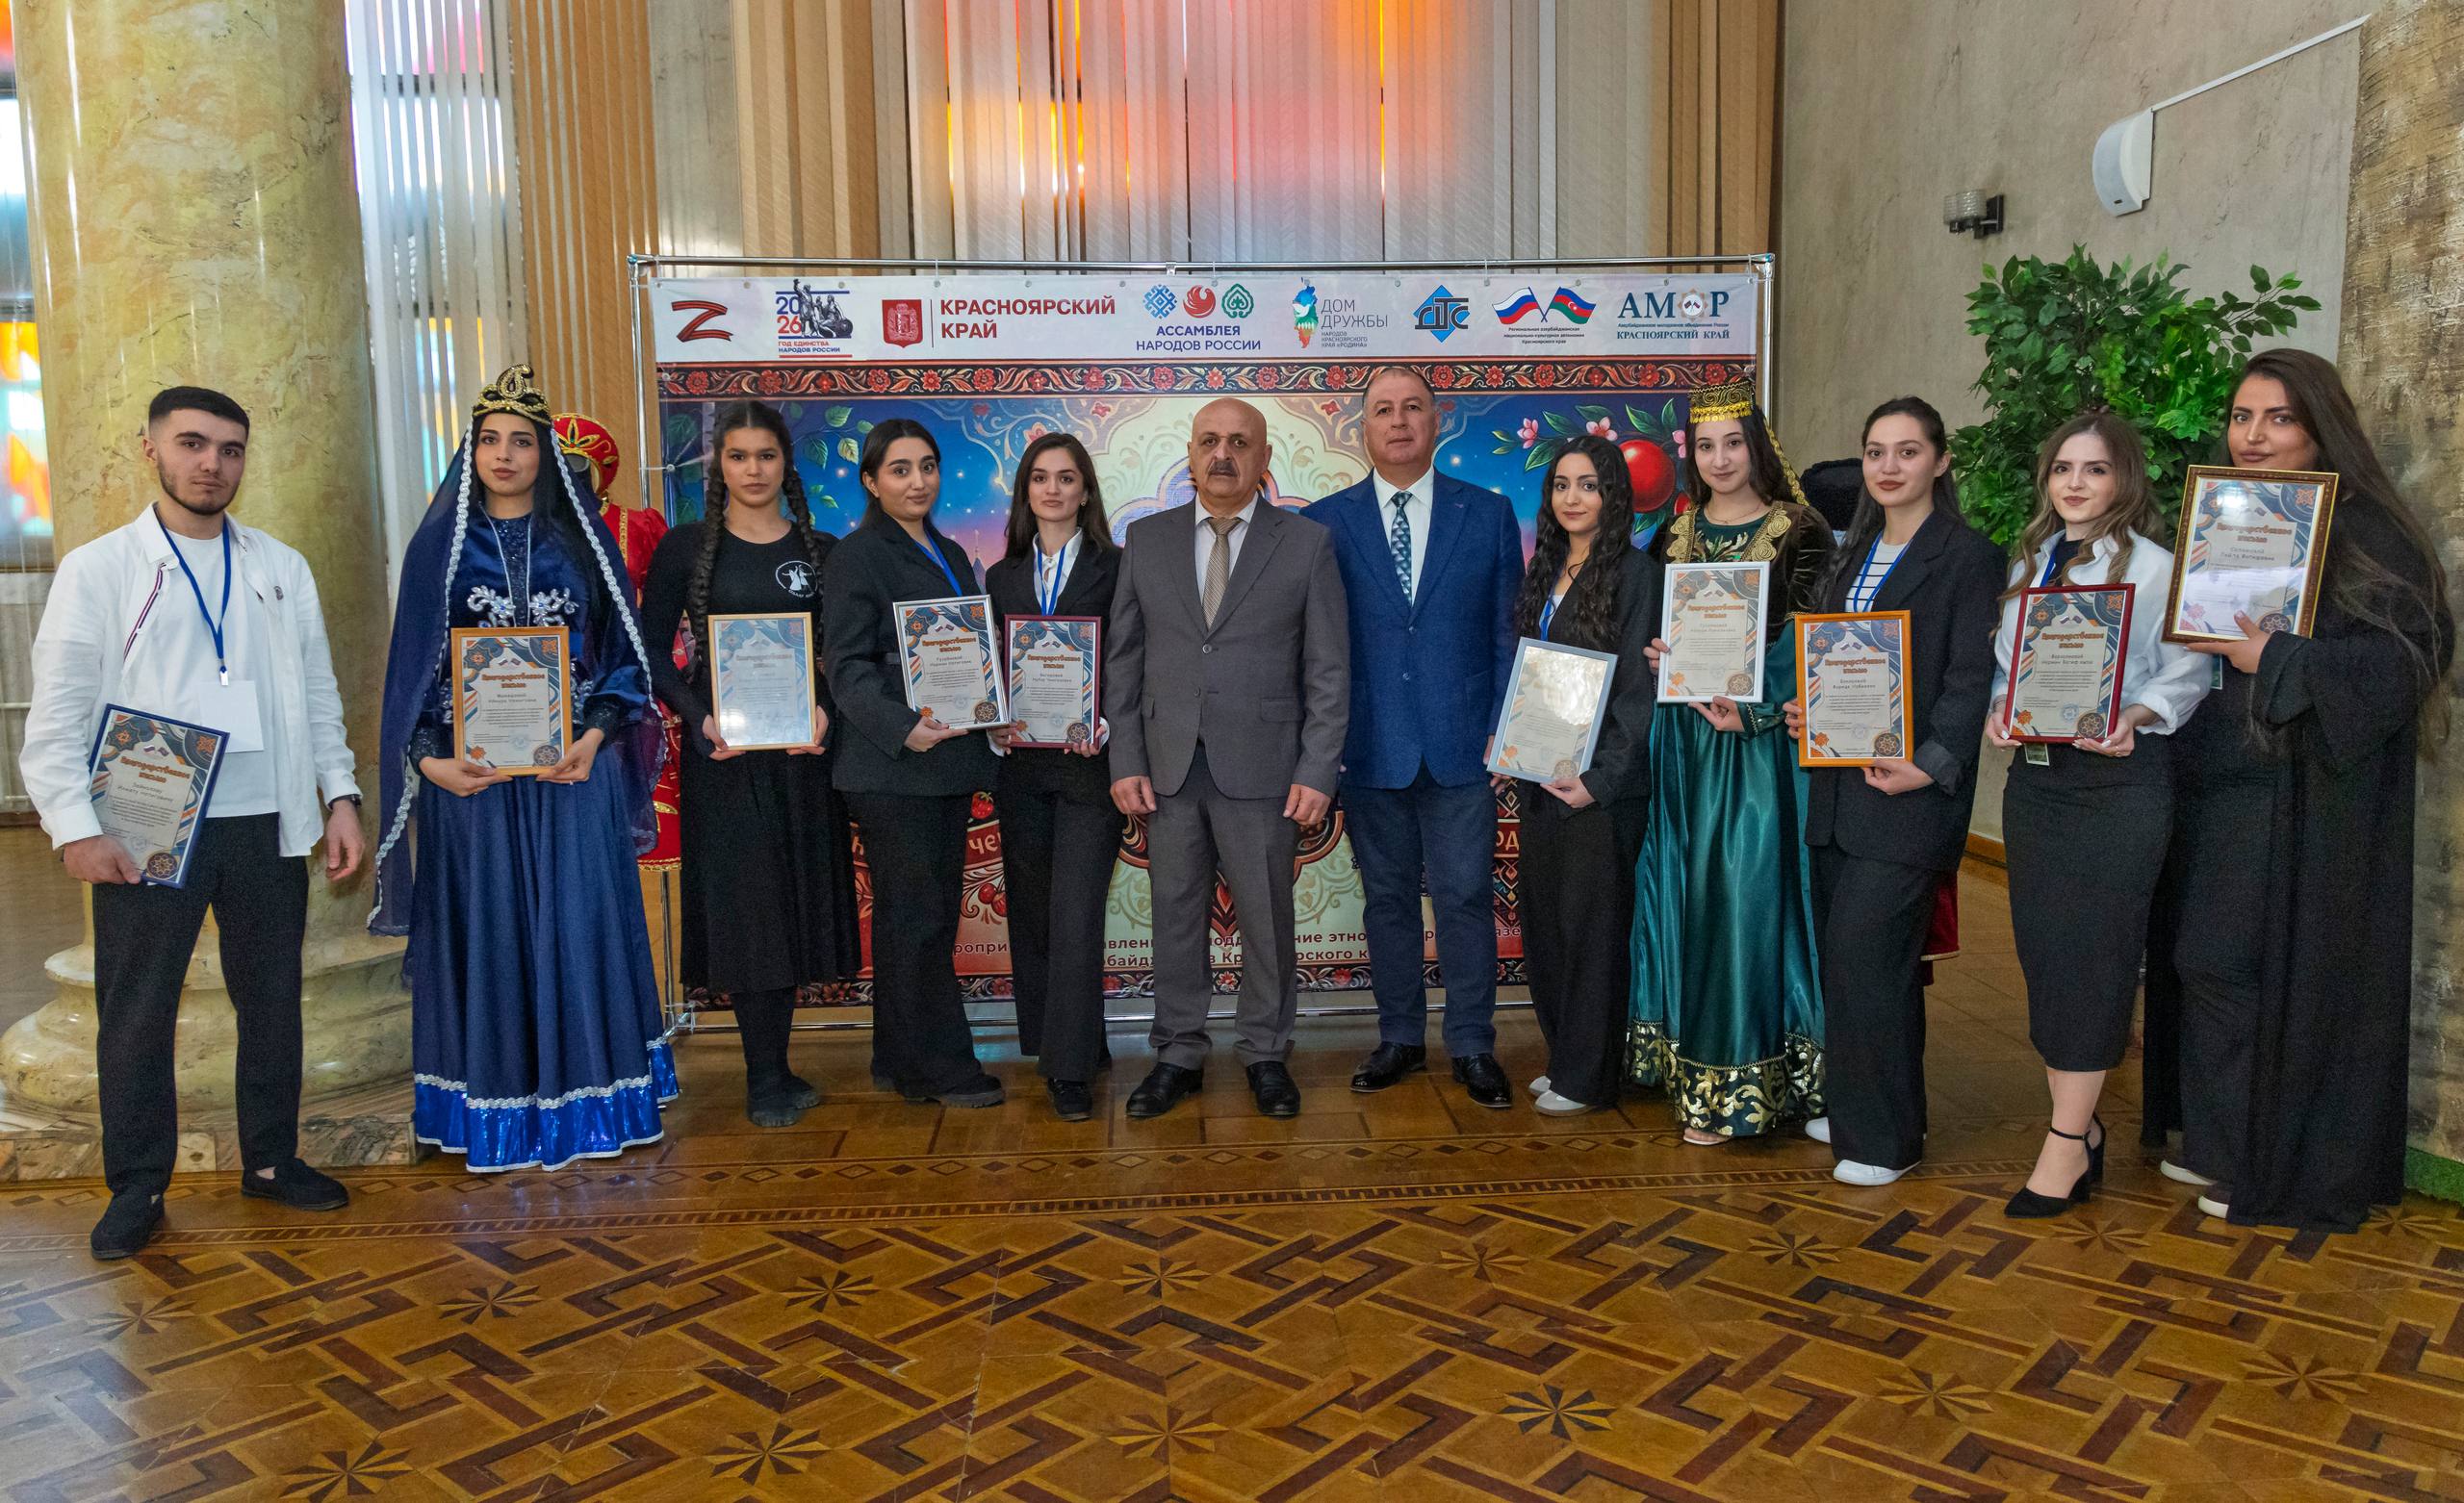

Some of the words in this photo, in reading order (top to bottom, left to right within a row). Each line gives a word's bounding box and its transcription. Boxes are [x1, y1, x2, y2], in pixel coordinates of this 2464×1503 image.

[939, 294, 1116, 315] КРАСНОЯРСКИЙ
[1321, 298, 1355, 315] ДОМ
[940, 318, 998, 339] КРАЙ
[1321, 315, 1388, 330] ДРУЖБЫ
[1156, 325, 1241, 336] АССАМБЛЕЯ
[1616, 329, 1699, 340] КРАСНОЯРСКИЙ
[1703, 329, 1730, 340] КРАЙ
[1136, 340, 1201, 352] НАРОДОВ
[1204, 340, 1261, 350] РОССИИ
